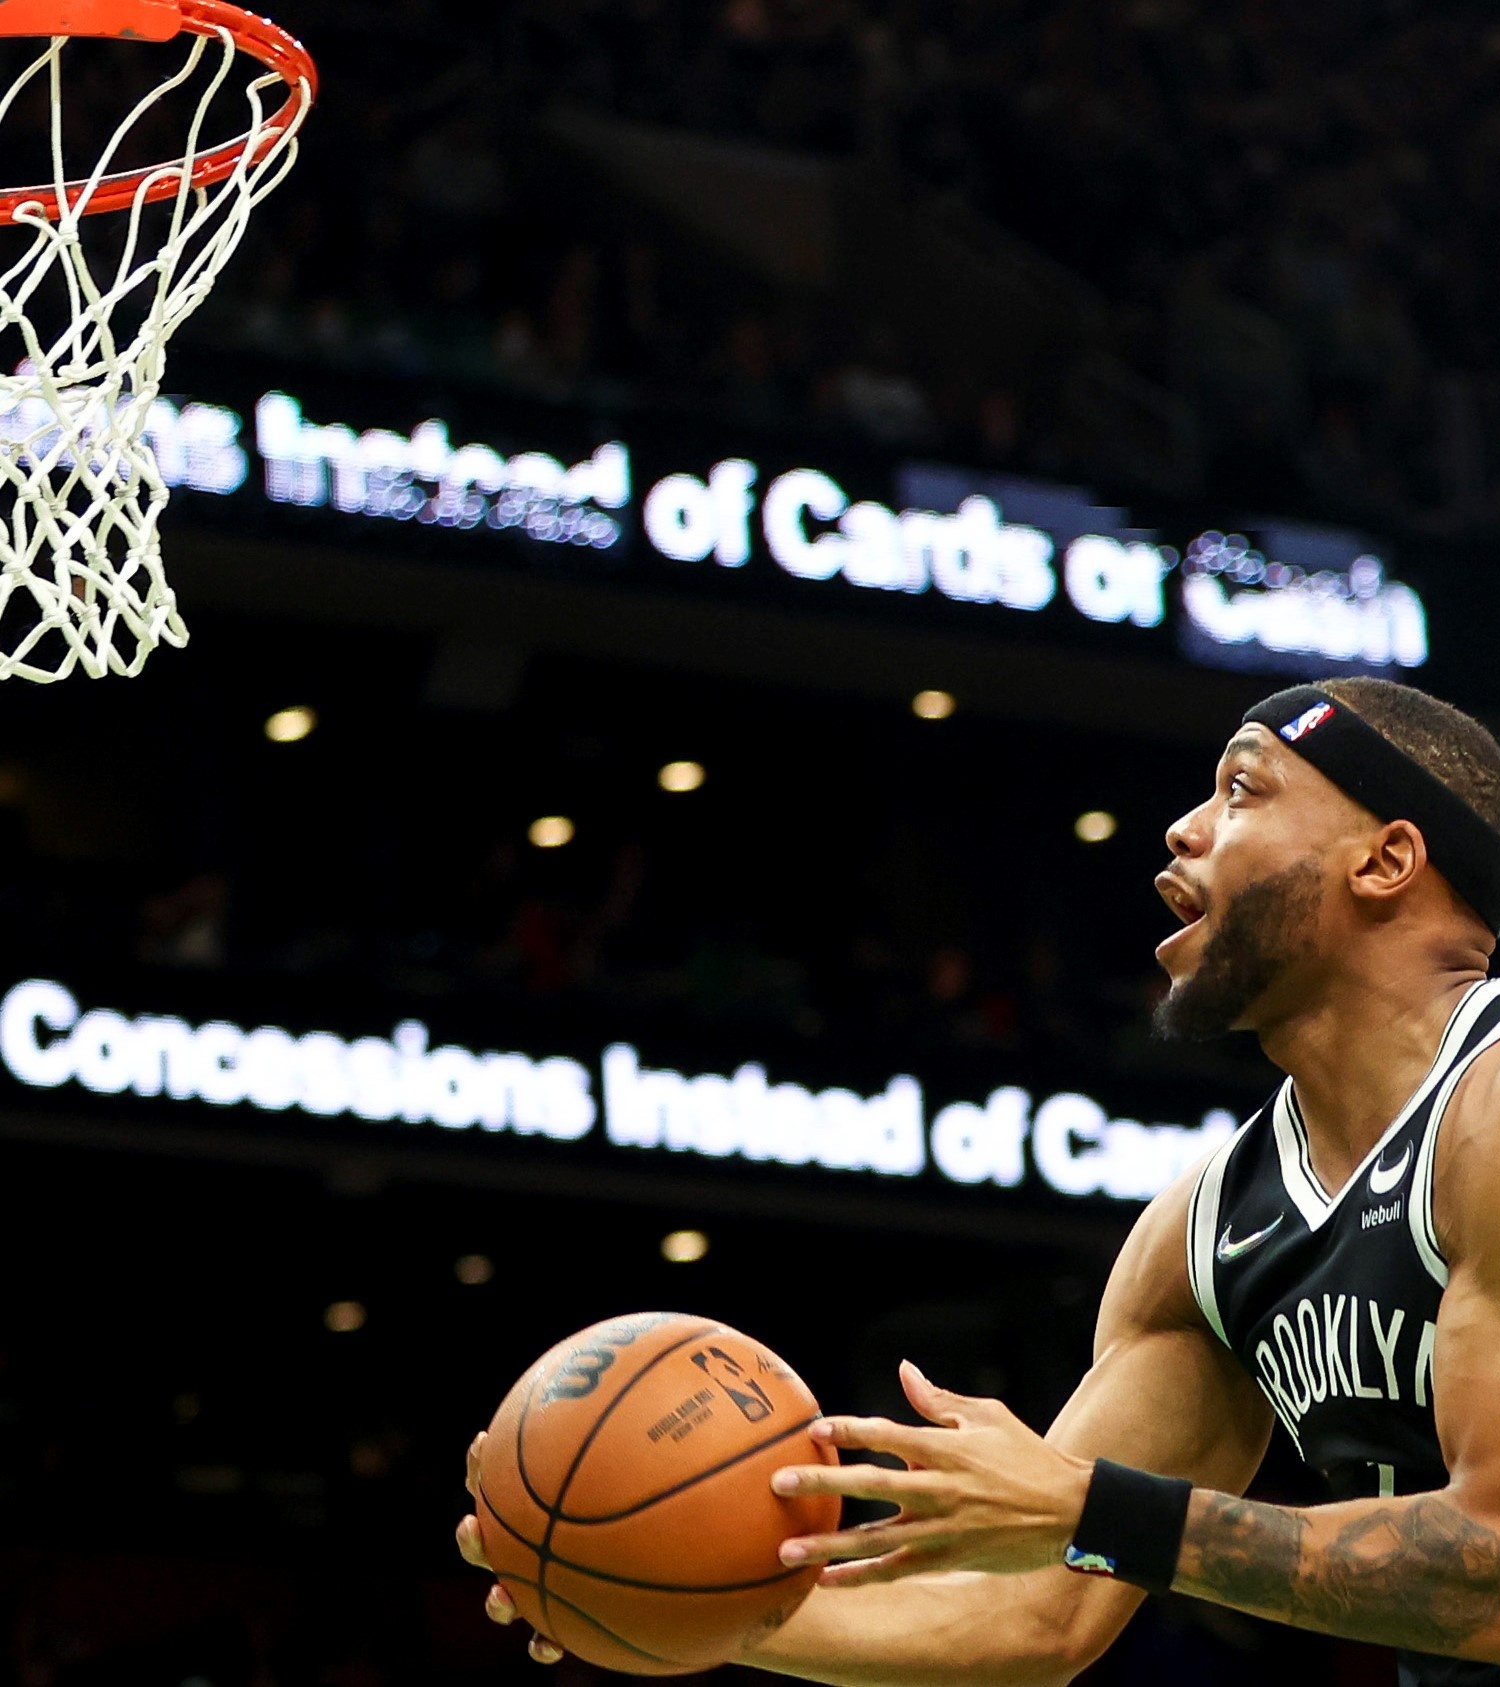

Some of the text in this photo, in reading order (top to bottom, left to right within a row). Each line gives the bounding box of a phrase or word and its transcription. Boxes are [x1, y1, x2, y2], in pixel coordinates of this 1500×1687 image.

[644, 458, 757, 568] of
[763, 468, 1056, 611] Cards
[1065, 533, 1167, 628] or
[0, 979, 596, 1140] Concessions
[602, 1043, 926, 1176] Instead
[931, 1086, 1031, 1187] of
[1361, 1199, 1401, 1230] Webull
[1256, 1293, 1438, 1462] ROOKLYN
